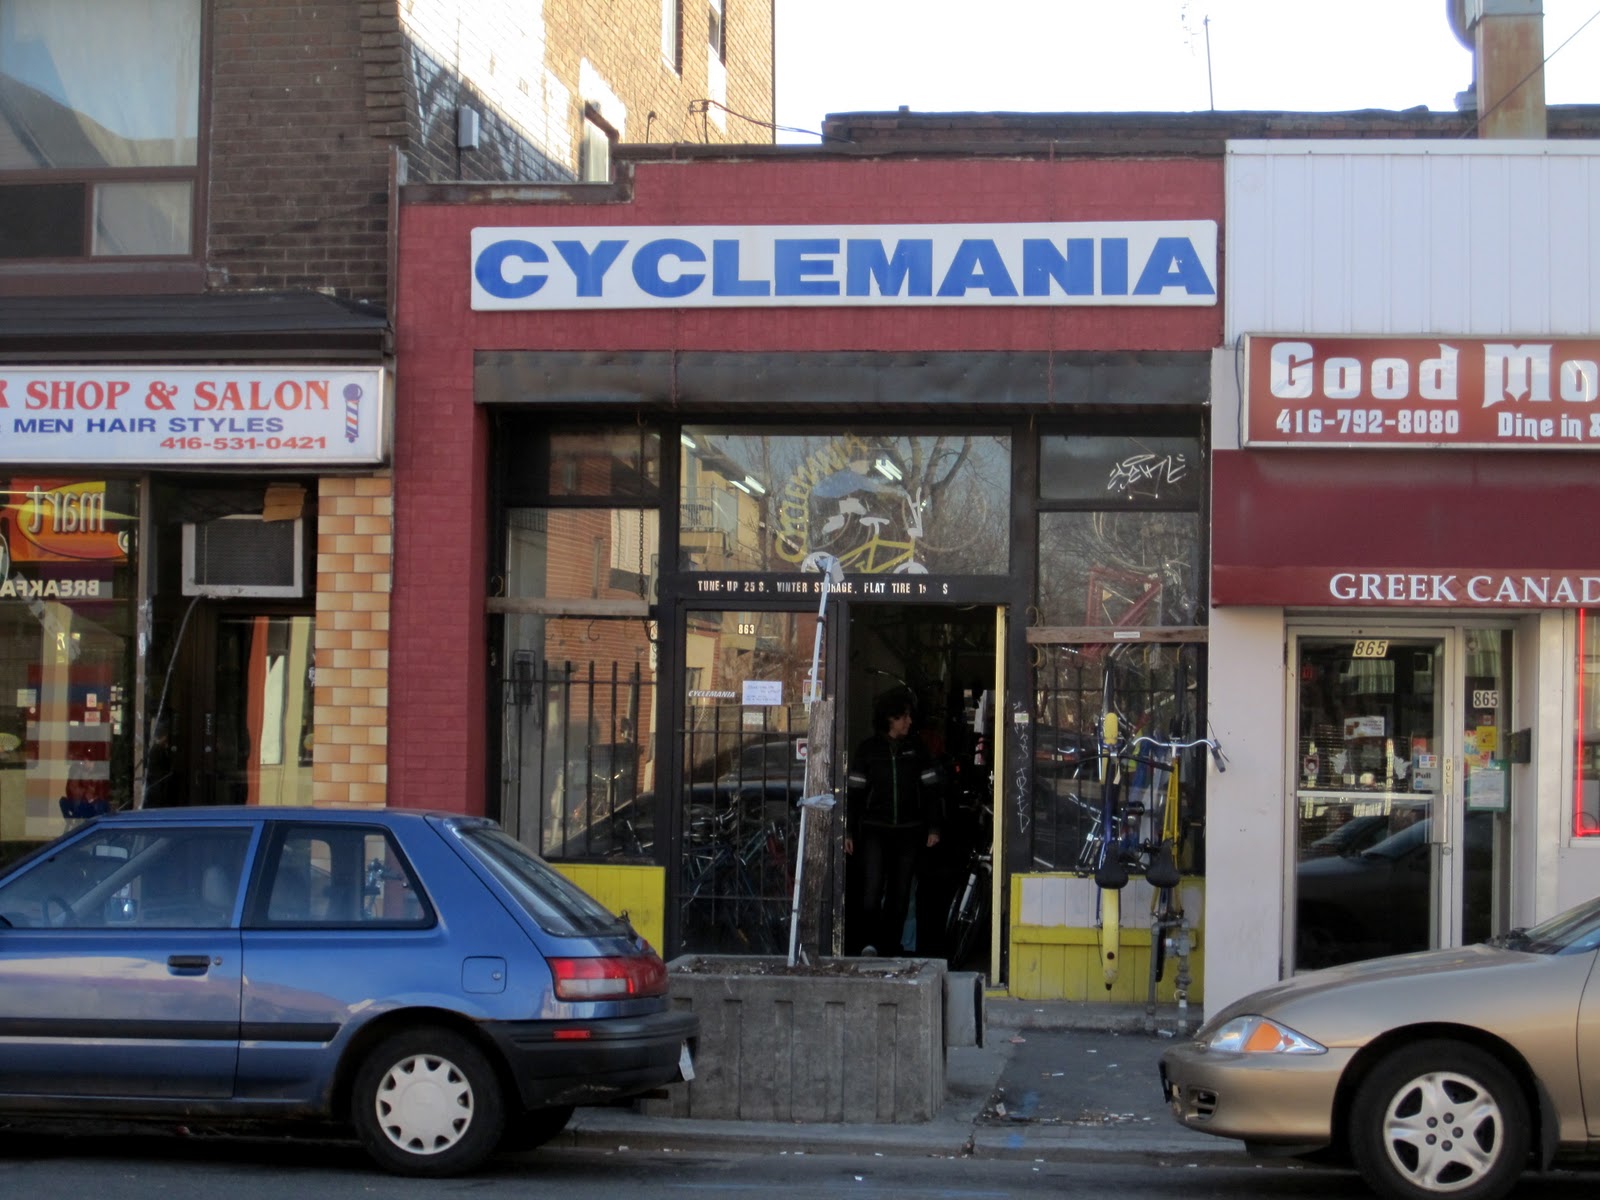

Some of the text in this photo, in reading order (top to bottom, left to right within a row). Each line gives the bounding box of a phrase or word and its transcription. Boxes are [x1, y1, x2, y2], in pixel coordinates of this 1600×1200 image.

[474, 236, 1216, 299] CYCLEMANIA
[1269, 341, 1599, 408] Good Mo
[24, 380, 131, 411] SHOP
[144, 380, 179, 411] &
[193, 379, 331, 411] SALON
[14, 417, 285, 434] MEN HAIR STYLES
[1275, 409, 1460, 434] 416-792-8080
[1497, 412, 1555, 441] Dine
[1560, 413, 1583, 441] in
[159, 436, 327, 450] 416-531-0421
[744, 581, 756, 593] 25
[863, 582, 886, 594] FLAT
[891, 582, 911, 594] TIRE
[1329, 573, 1600, 604] GREEK CANAD
[738, 624, 755, 635] 863
[1355, 641, 1387, 656] 865
[688, 690, 736, 699] CYCLEMANIA
[1474, 691, 1499, 708] 865
